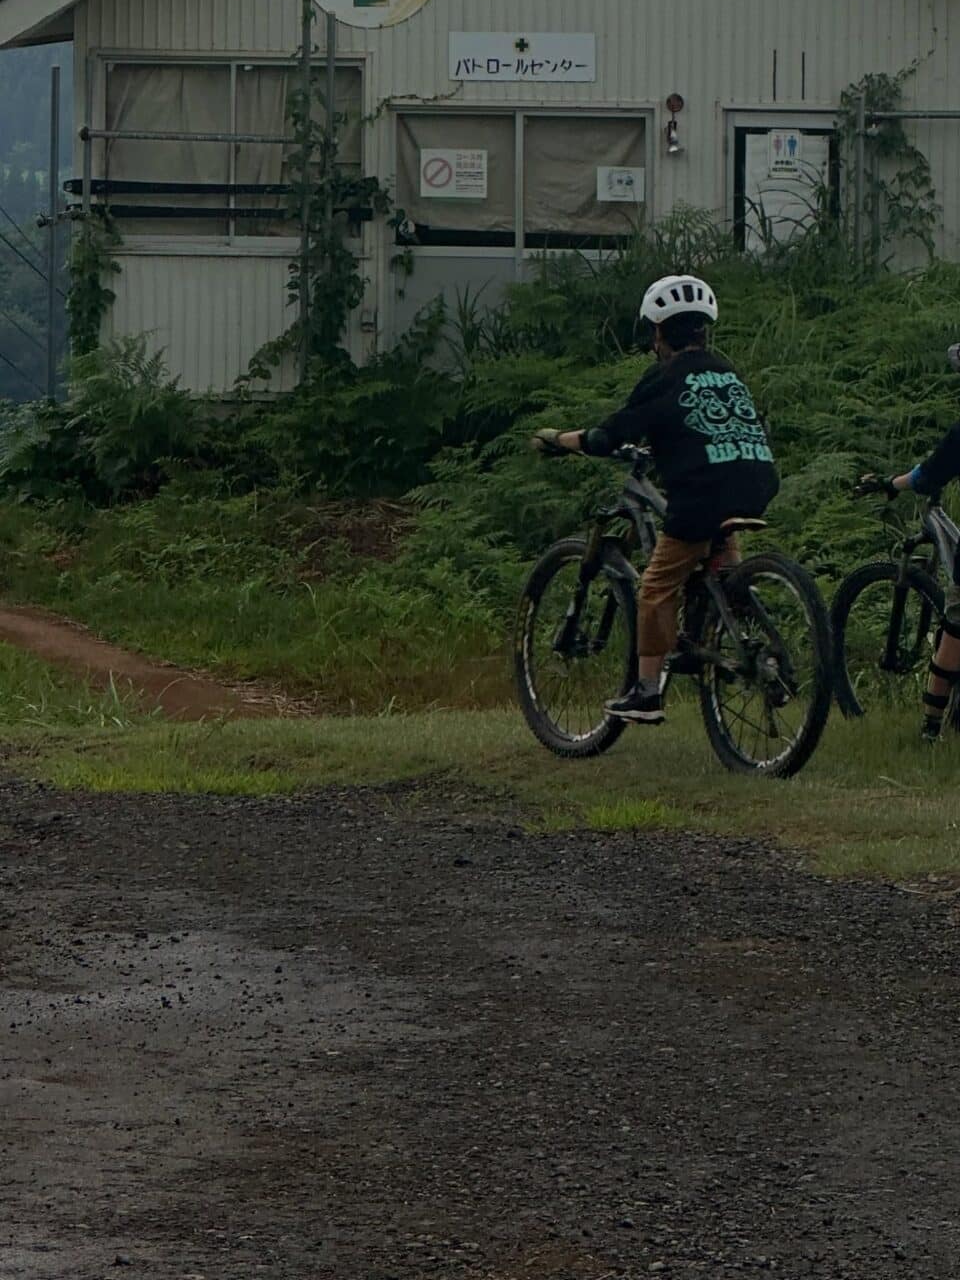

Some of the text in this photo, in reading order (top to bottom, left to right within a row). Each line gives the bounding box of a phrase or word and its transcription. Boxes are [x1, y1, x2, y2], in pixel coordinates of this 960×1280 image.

[455, 58, 589, 76] パトロールセンター
